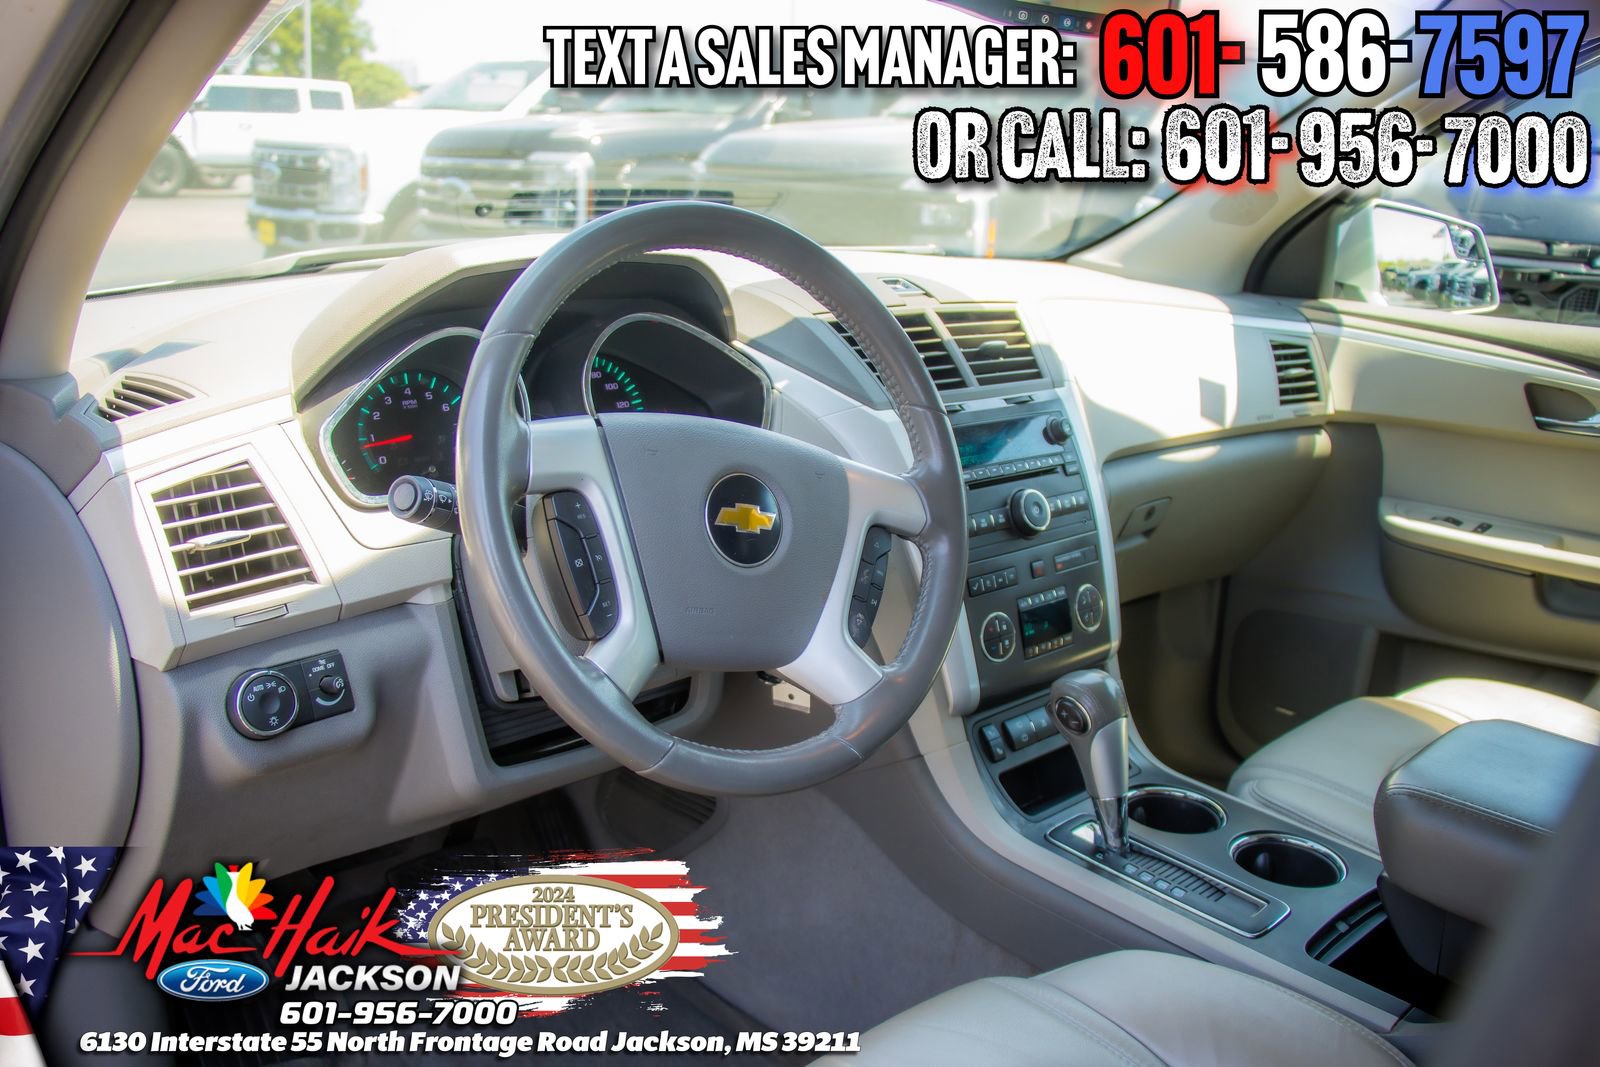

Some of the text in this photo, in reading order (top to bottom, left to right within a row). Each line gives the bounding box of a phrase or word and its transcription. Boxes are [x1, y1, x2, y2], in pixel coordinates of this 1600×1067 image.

[605, 382, 619, 390] 100
[403, 387, 412, 395] 4
[425, 391, 433, 400] 5
[384, 396, 393, 405] 3
[616, 401, 630, 409] 120
[442, 403, 450, 412] 6
[372, 411, 381, 420] 2
[378, 455, 387, 465] 0
